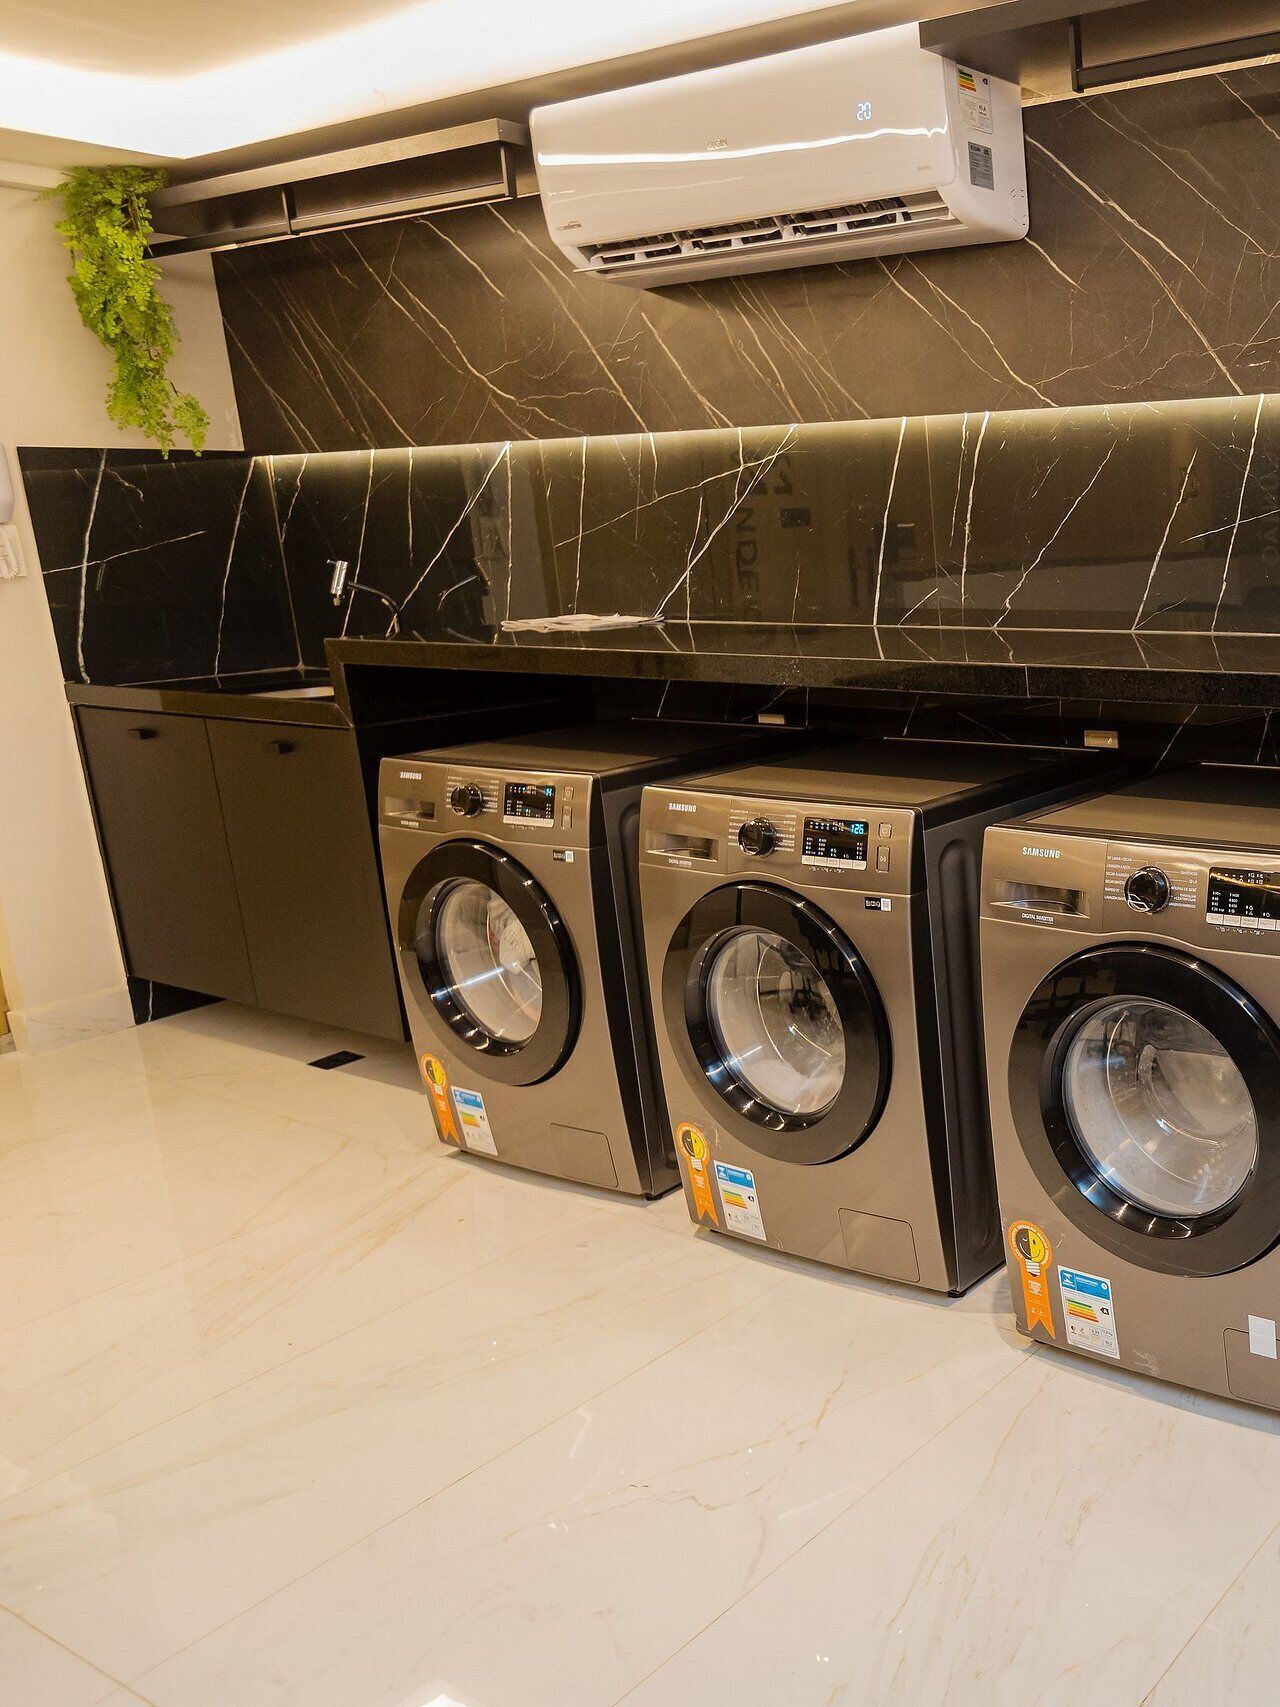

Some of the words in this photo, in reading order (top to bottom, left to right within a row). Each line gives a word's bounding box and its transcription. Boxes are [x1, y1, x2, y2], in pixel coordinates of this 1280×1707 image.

[856, 102, 872, 121] 20
[668, 802, 697, 813] SAMSUNG
[1022, 846, 1061, 859] SAMSUNG
